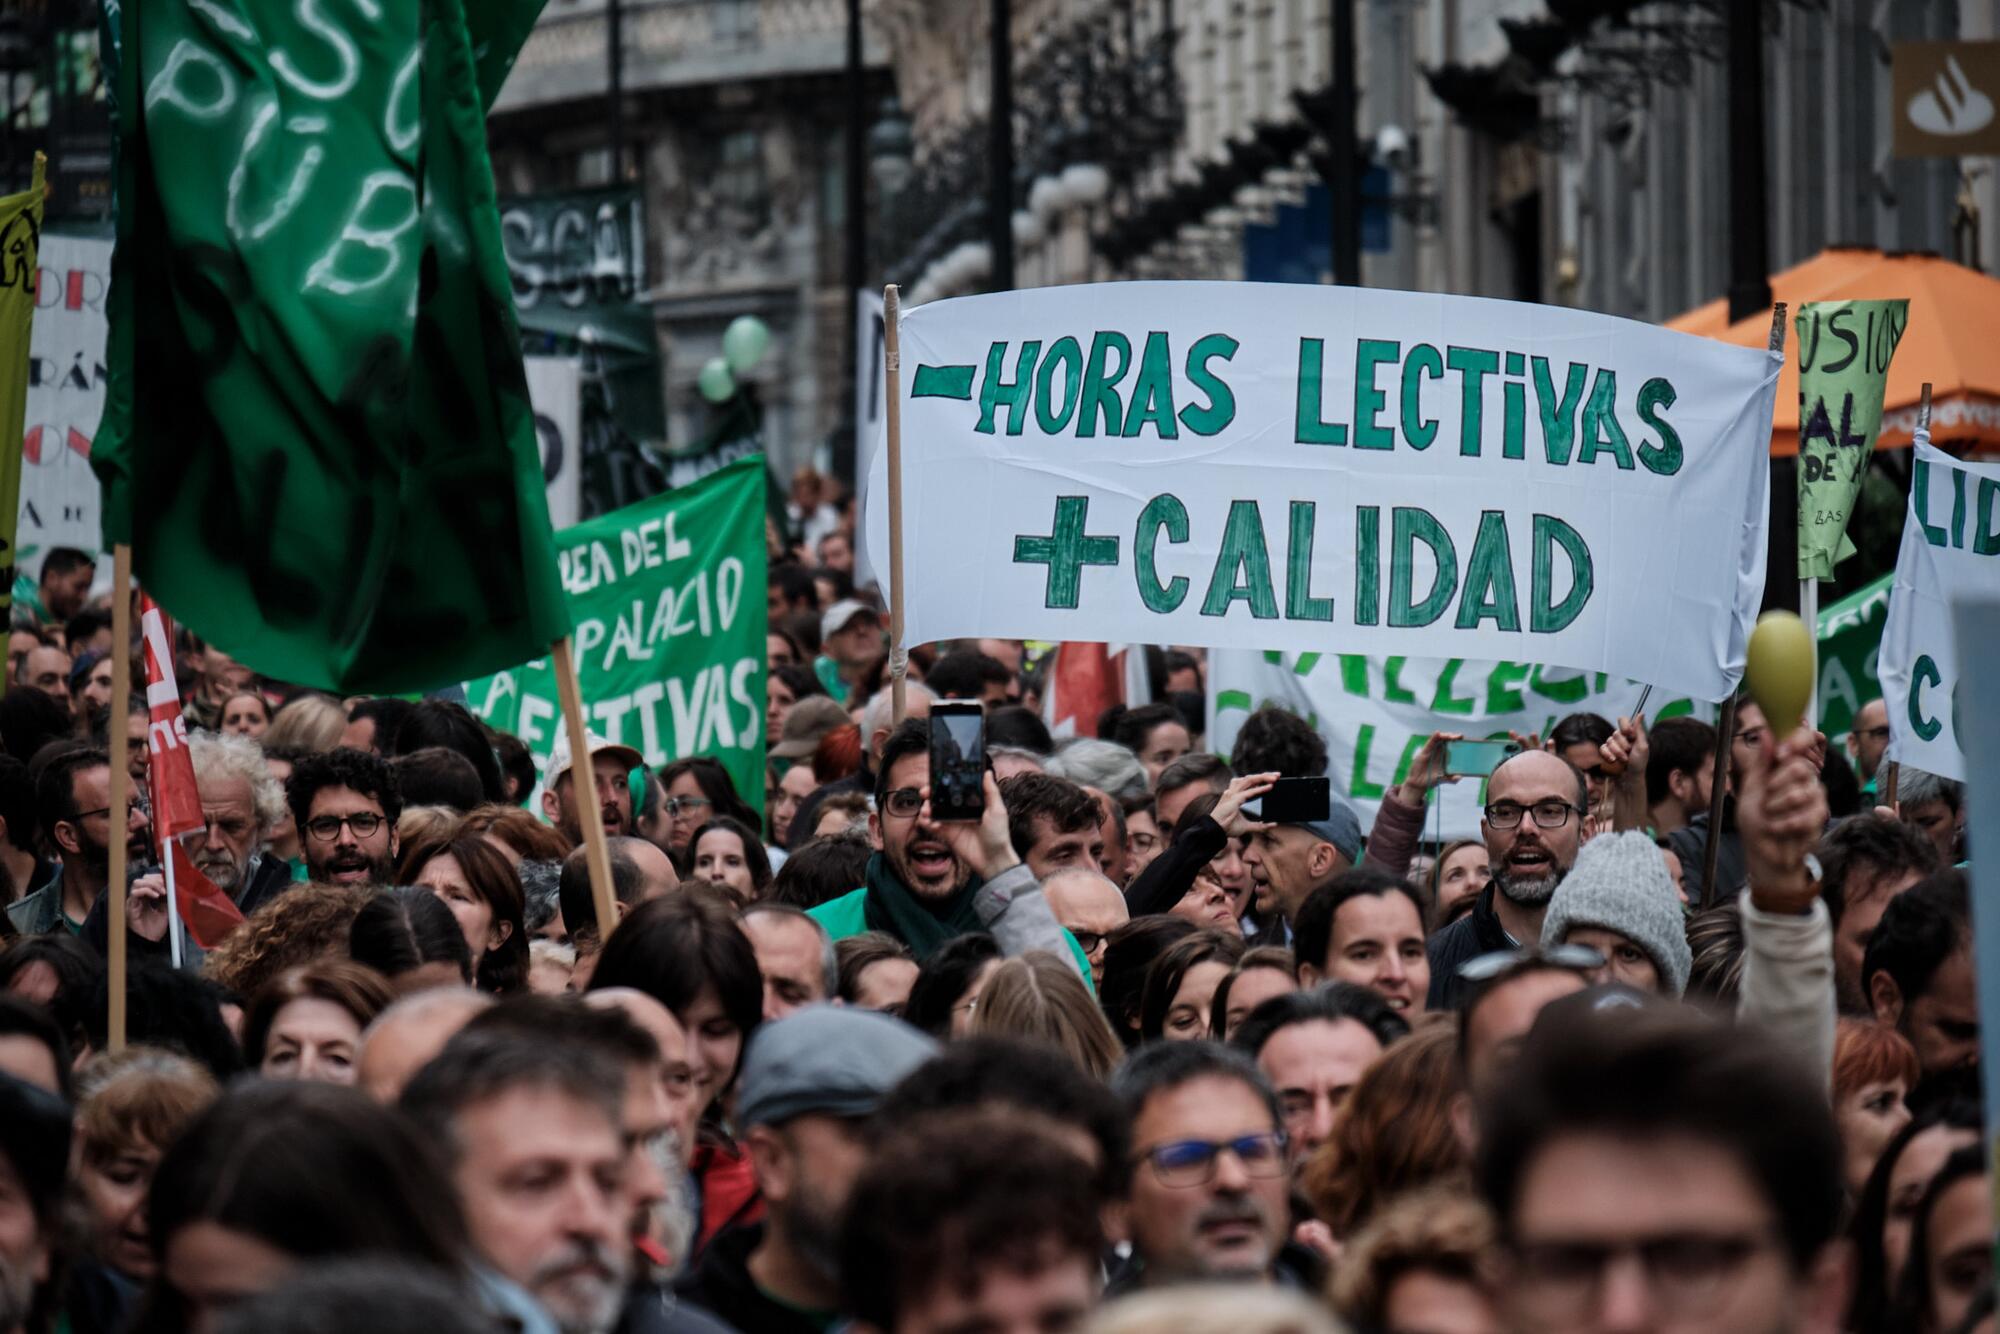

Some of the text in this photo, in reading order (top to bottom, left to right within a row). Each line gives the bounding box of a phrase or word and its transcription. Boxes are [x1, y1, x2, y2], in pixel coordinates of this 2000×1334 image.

[1800, 392, 1867, 449] AL
[1805, 452, 1837, 484] DE
[620, 511, 692, 575] DEL
[574, 557, 744, 675] PALACIO
